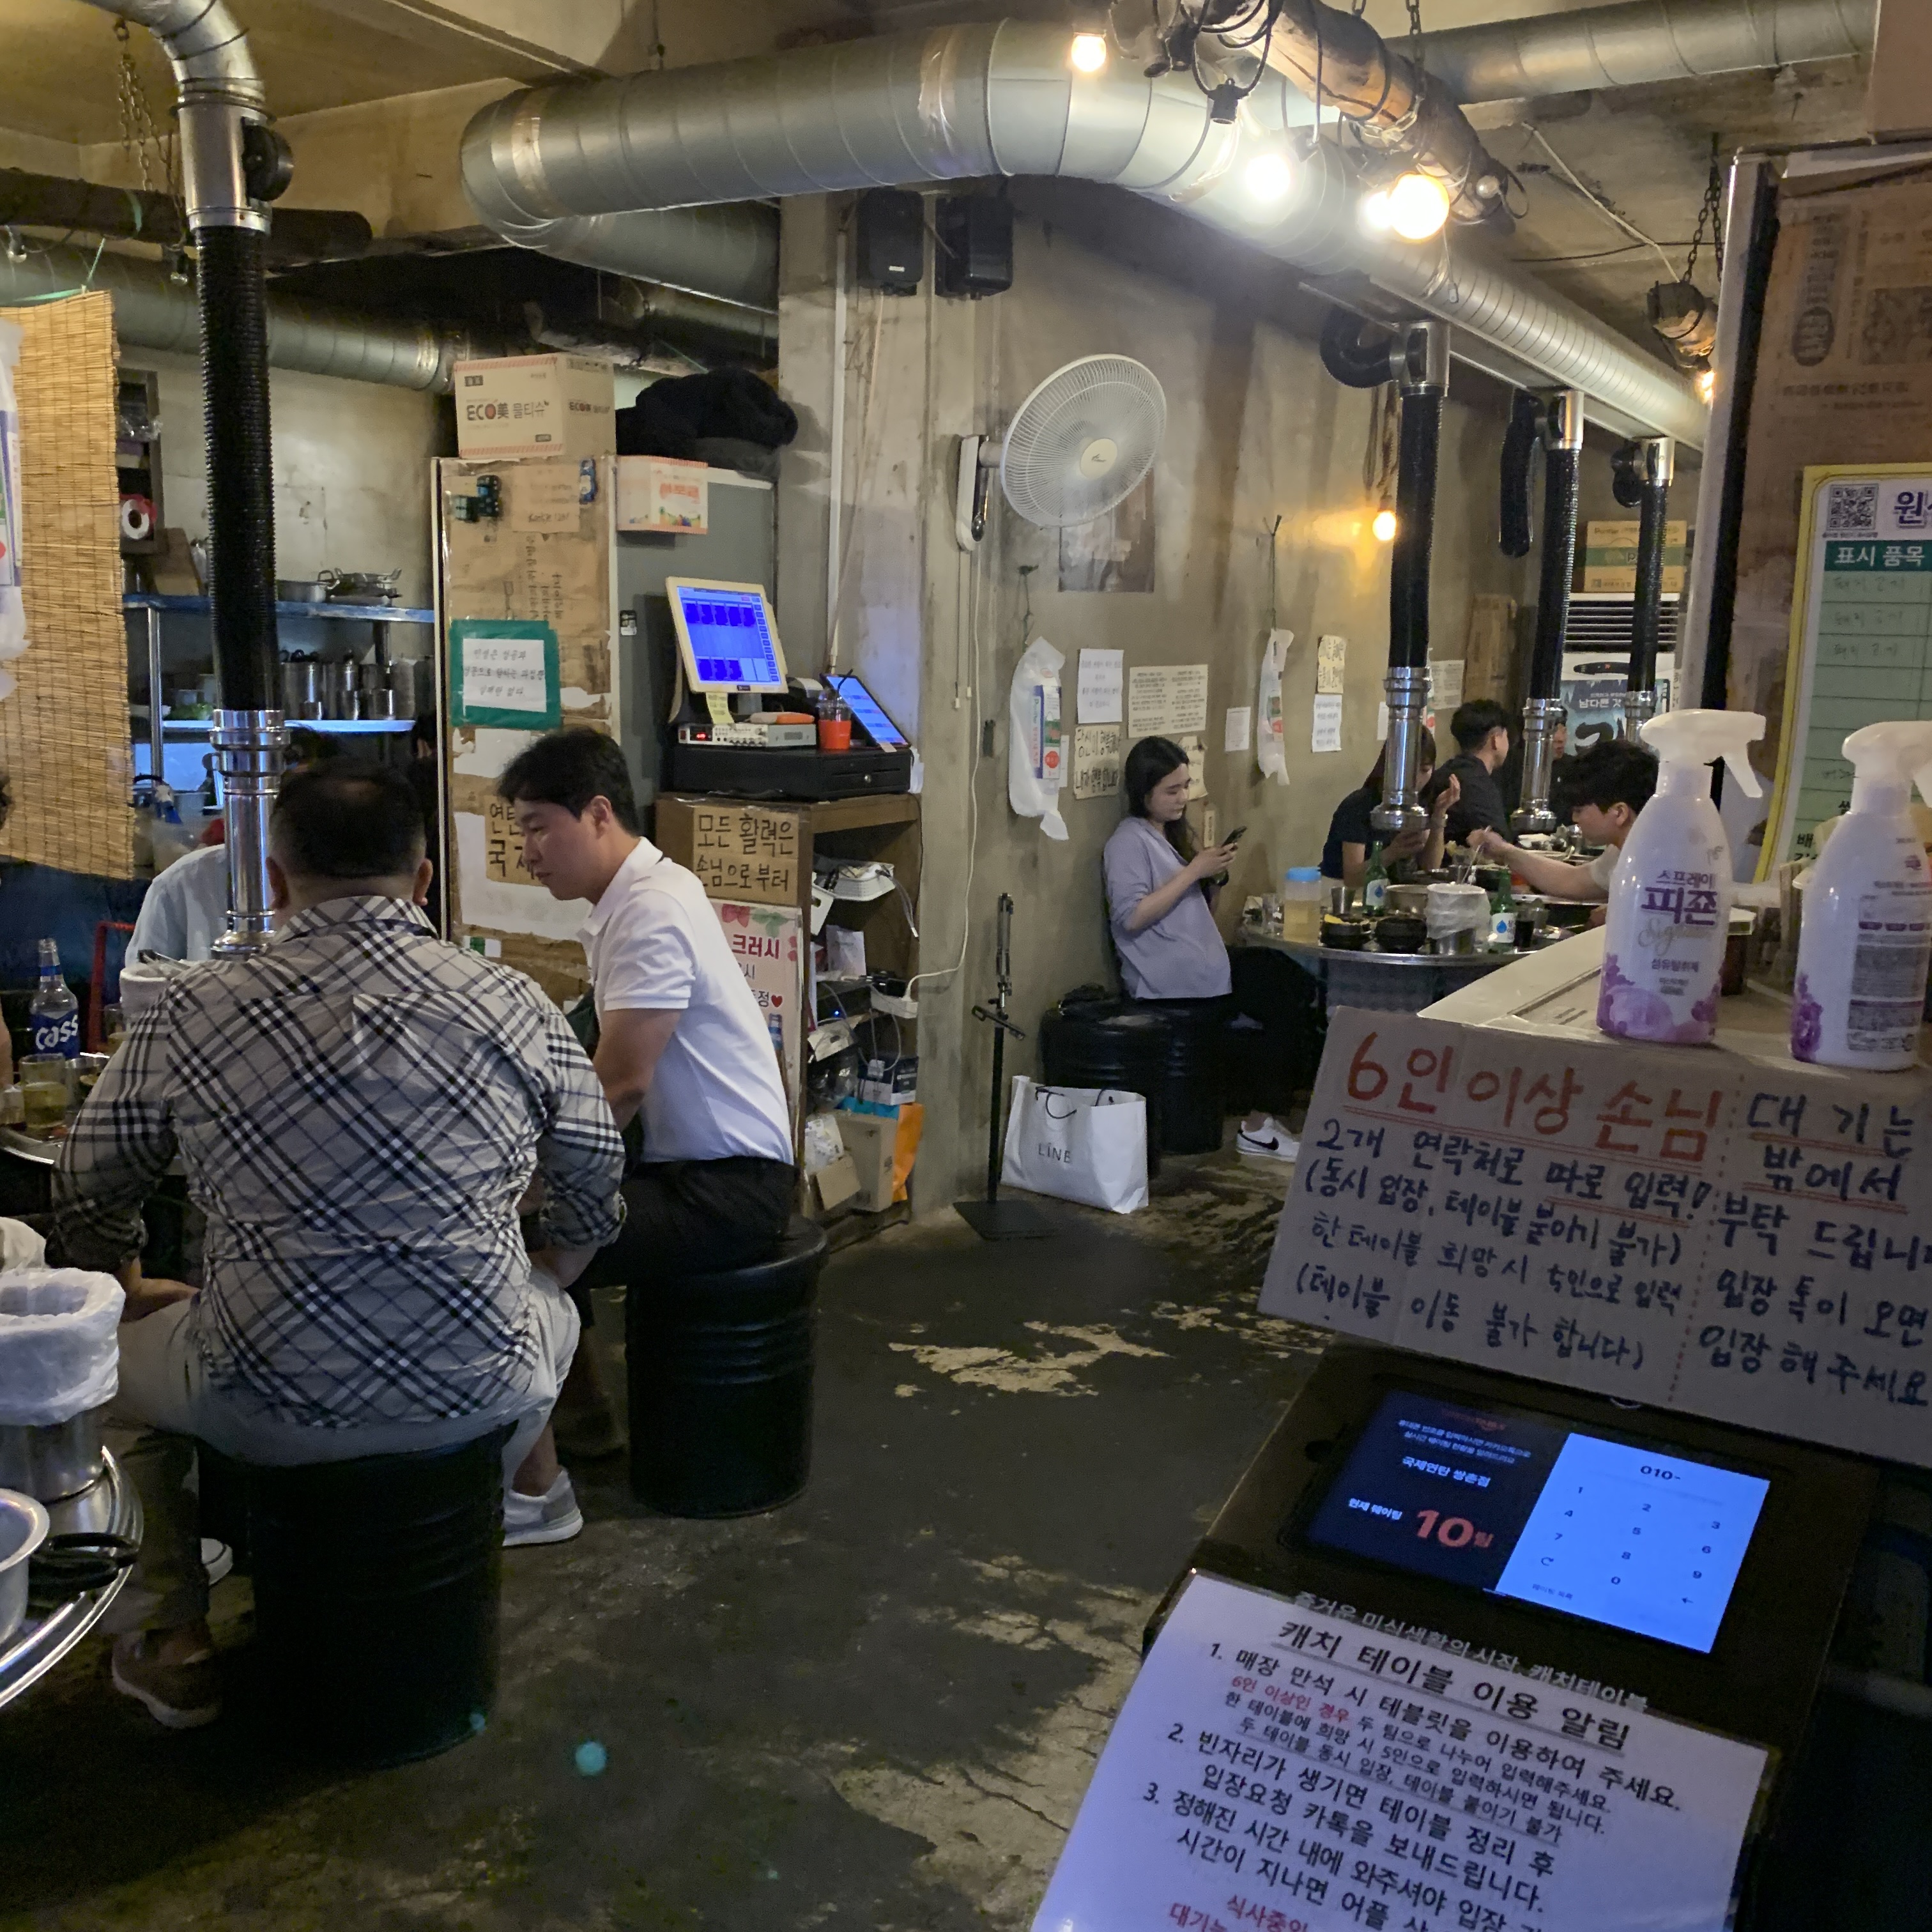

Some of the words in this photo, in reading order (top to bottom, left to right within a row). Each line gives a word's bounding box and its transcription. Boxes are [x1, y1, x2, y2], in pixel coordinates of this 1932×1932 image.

[1894, 491, 1932, 525] 원
[1834, 545, 1876, 567] 표시
[1883, 546, 1925, 567] 품목
[697, 815, 732, 848] 모든
[739, 813, 794, 857] 활력은
[1656, 870, 1717, 889] 스프레이
[1641, 887, 1718, 924] 피죤
[732, 934, 780, 960] 크러시
[1595, 1080, 1723, 1162] 손님
[1038, 1142, 1071, 1164] LINE
[1316, 1118, 1385, 1158] 2개
[1413, 1130, 1525, 1186] 연락처로
[1546, 1160, 1606, 1200] 따로
[1763, 1144, 1902, 1201] 밖에서
[1312, 1211, 1340, 1248] 한
[1348, 1223, 1423, 1268] 테이블
[1501, 1254, 1528, 1285] 시
[1411, 1289, 1460, 1333] 이동
[1864, 1301, 1929, 1349] 오면
[1826, 1351, 1929, 1406] 주세요
[1578, 1485, 1584, 1494] 1
[1641, 1503, 1652, 1512] 2
[1711, 1520, 1721, 1529] 3
[1610, 1575, 1621, 1585] 0
[1692, 1570, 1703, 1579] 9
[1278, 1621, 1343, 1659] 캐치
[1357, 1645, 1453, 1695] 테이블
[1473, 1681, 1539, 1721] 이용
[1560, 1706, 1630, 1751] 알림
[1211, 1643, 1222, 1660] 1.
[1236, 1649, 1280, 1677] 매장
[1290, 1666, 1334, 1696] 만석
[1344, 1686, 1368, 1707] 시
[1379, 1695, 1472, 1742] 테블릿을
[1486, 1730, 1586, 1780] 이용하여
[1598, 1765, 1681, 1811] 주세요.
[1230, 1675, 1257, 1693] 6인
[1264, 1684, 1311, 1711] 이상인
[1359, 1715, 1374, 1733] 두
[1383, 1724, 1431, 1752] 팀으로
[1440, 1743, 1492, 1774] 나누어
[1225, 1691, 1241, 1708] 한
[1247, 1698, 1311, 1733] 테이블에
[1316, 1722, 1351, 1746] 희망
[1357, 1737, 1374, 1755] 시
[1381, 1745, 1441, 1776] 5인으로
[1452, 1767, 1538, 1811] 입력하시면
[1547, 1799, 1606, 1835] 됩니다.
[1239, 1716, 1255, 1734] 두
[1263, 1724, 1310, 1754] 테이블
[1318, 1744, 1351, 1768] 동시
[1404, 1773, 1455, 1805] 테이블
[1168, 1722, 1184, 1744] 2.
[1198, 1730, 1287, 1781] 빈자리가
[1298, 1767, 1368, 1811] 생기면
[1379, 1795, 1452, 1842] 테이블
[1466, 1825, 1516, 1866] 정리
[1528, 1850, 1556, 1878] 후
[1143, 1781, 1160, 1805] 3.
[1173, 1790, 1237, 1834] 정해진
[1243, 1819, 1290, 1855] 시간
[1298, 1837, 1345, 1877] 내에
[1349, 1859, 1448, 1917] 와주셔야
[1202, 1763, 1293, 1816] 입장요청
[1303, 1802, 1374, 1848] 카톡을
[1384, 1832, 1544, 1914] 보내드립니다.
[1176, 1828, 1246, 1874] 시간이
[1256, 1857, 1329, 1906] 지나면
[1341, 1891, 1389, 1932] 어플
